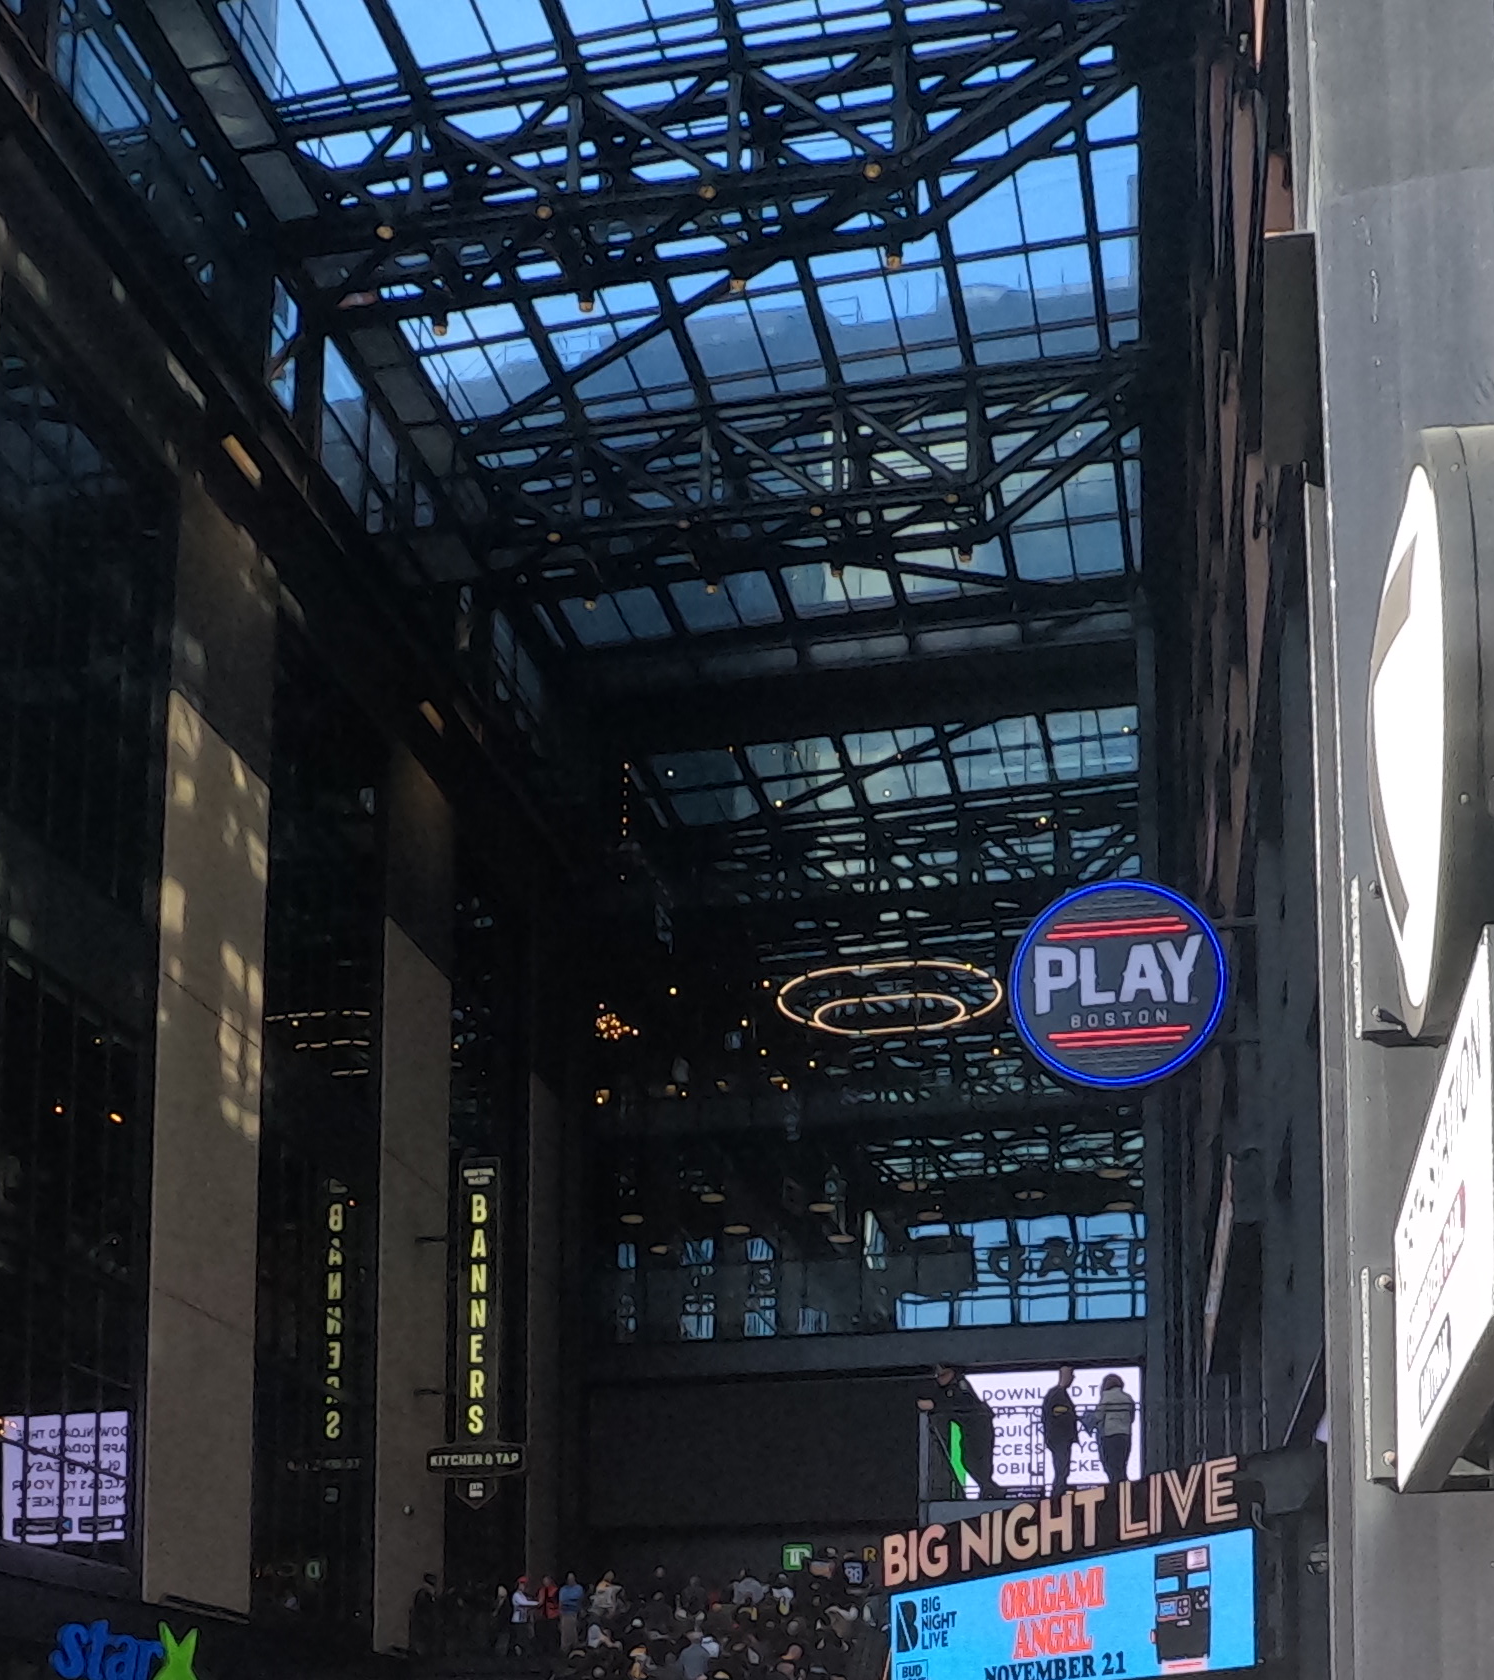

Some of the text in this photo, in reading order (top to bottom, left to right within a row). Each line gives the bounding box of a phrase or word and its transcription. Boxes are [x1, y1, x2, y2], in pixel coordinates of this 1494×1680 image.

[1034, 933, 1204, 1016] PLAY
[1070, 1009, 1169, 1029] BOSTON
[468, 1193, 488, 1435] BANNERS
[982, 1386, 1083, 1401] DOWNLD
[992, 1443, 1044, 1456] CCESS
[430, 1453, 483, 1468] KITCHEN
[495, 1452, 519, 1466] TAP
[995, 1462, 1045, 1475] OBILE
[882, 1455, 1239, 1587] BIG NIGHT LIVE
[1000, 1566, 1105, 1621] ORIGAMI
[921, 1596, 941, 1614] BIG
[921, 1610, 957, 1632] NIGHT
[921, 1630, 949, 1650] LIVE
[1013, 1611, 1092, 1660] ANGEL
[902, 1664, 923, 1679] BUD
[1101, 1651, 1127, 1676] 21
